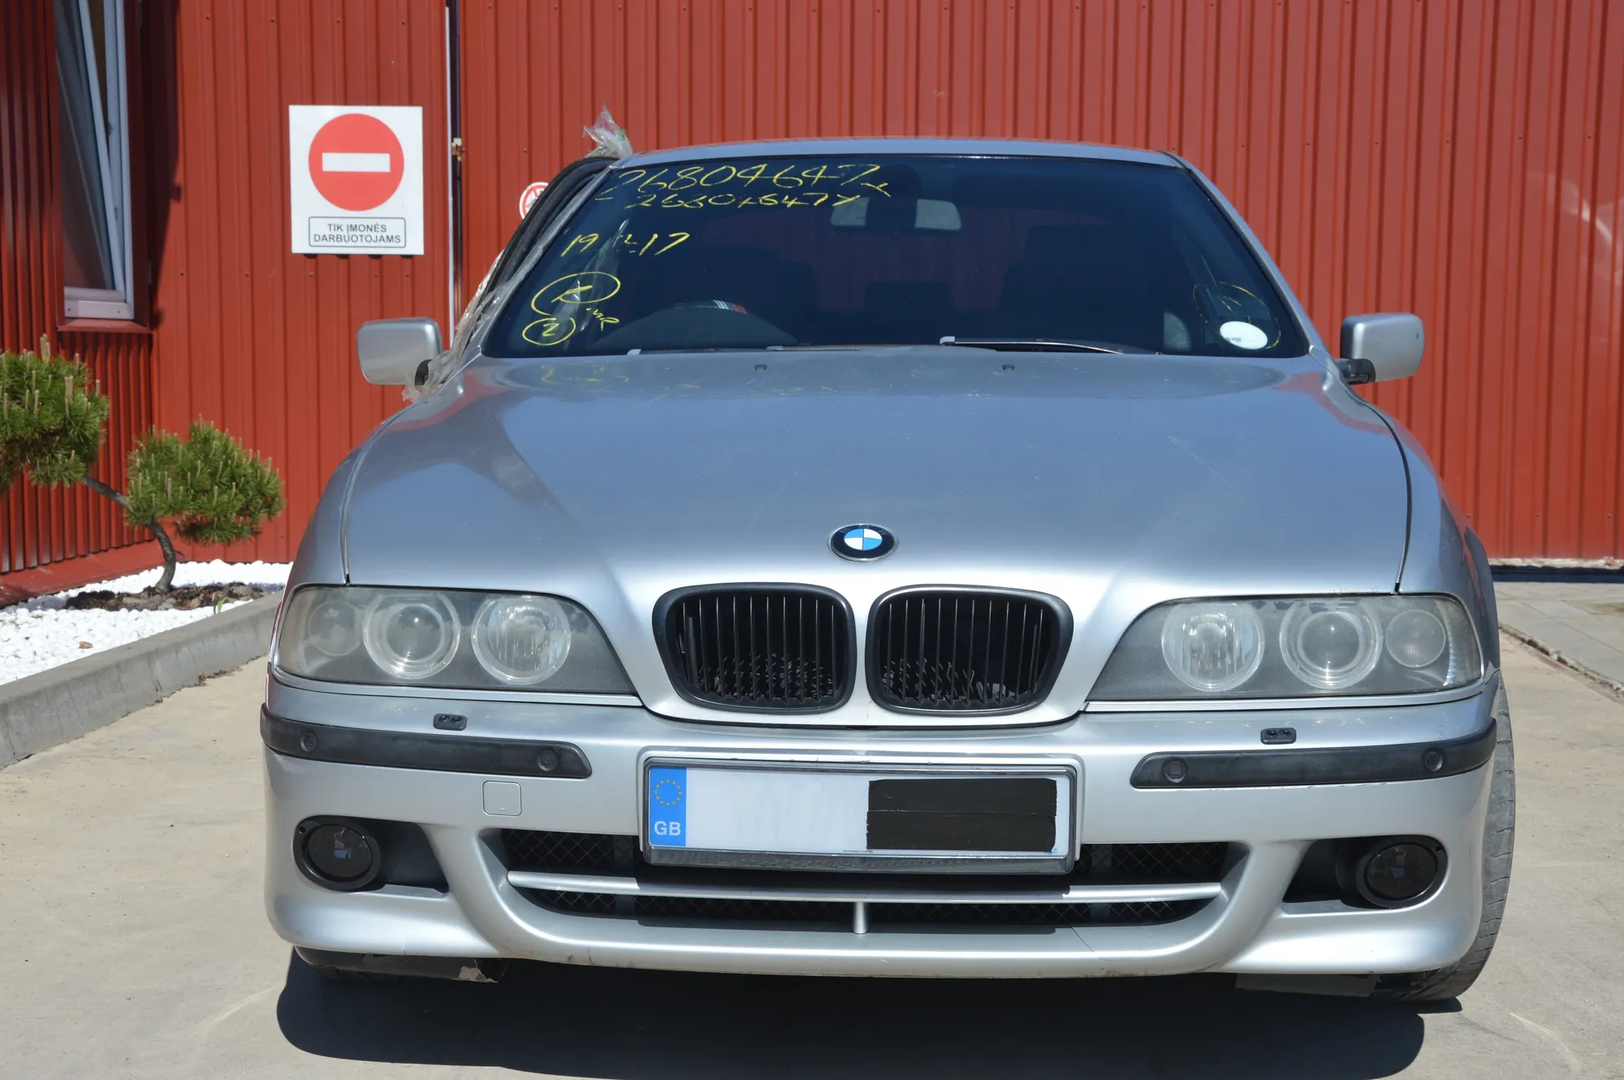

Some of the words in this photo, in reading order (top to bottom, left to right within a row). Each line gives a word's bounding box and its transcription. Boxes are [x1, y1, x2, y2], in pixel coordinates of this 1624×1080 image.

[327, 223, 344, 232] TIK
[346, 222, 387, 234] ĮMONĖS
[313, 233, 402, 244] DARBUOTOJAMS
[653, 820, 682, 837] GB
